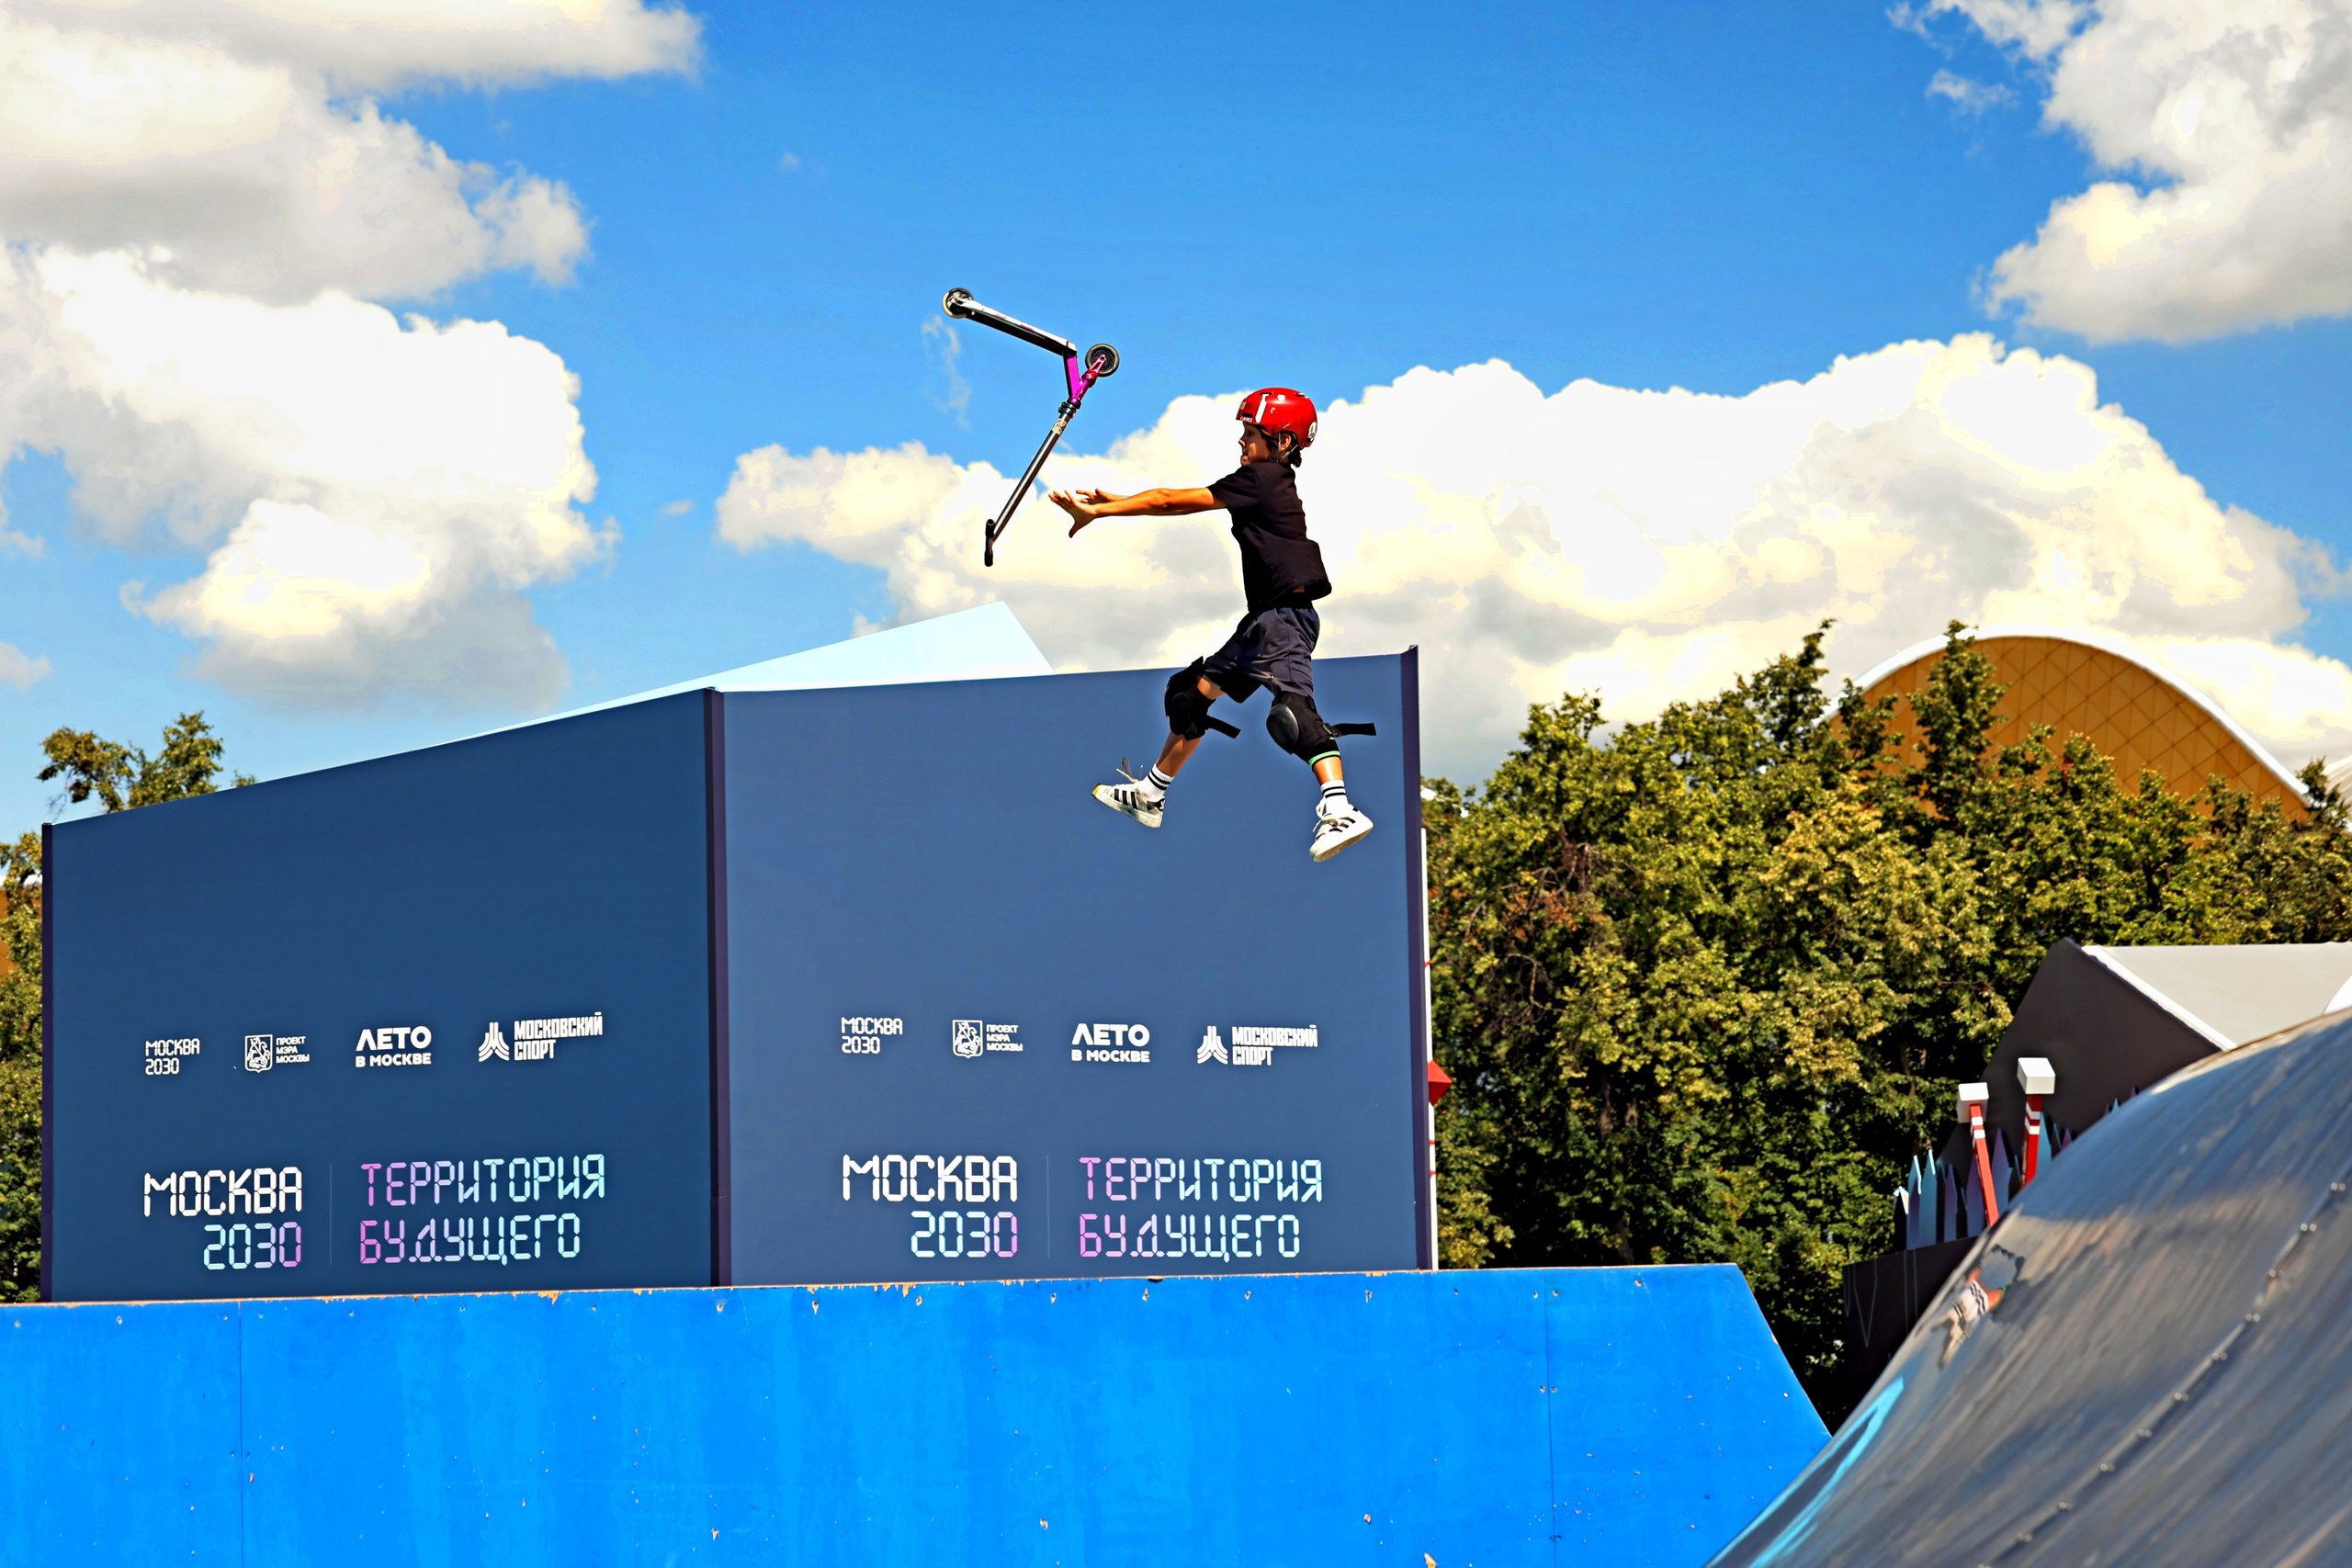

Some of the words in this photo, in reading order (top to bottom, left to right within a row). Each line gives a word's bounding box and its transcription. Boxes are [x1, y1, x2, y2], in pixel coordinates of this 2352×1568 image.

[514, 1011, 603, 1040] МОСКОВСКИЙ
[841, 1017, 903, 1035] МОСКВА
[986, 1024, 1019, 1033] ПРОЕКТ
[1071, 1023, 1150, 1046] ЛЕТО
[1232, 1024, 1318, 1047] МОСКОВСКИЙ
[145, 1038, 200, 1056] МОСКВА
[276, 1036, 306, 1045] ПРОЕКТ
[356, 1026, 432, 1051] ЛЕТО
[841, 1036, 881, 1055] 2030
[986, 1033, 1011, 1043] МЭРА
[986, 1043, 1023, 1052] МОСКВЫ
[276, 1045, 299, 1055] МЭРА
[276, 1054, 311, 1064] МОСКВЫ
[356, 1055, 366, 1067] В
[370, 1053, 432, 1066] МОСКВЕ
[514, 1039, 556, 1061] СПОРТ
[1071, 1049, 1082, 1061] В
[1087, 1050, 1150, 1062] МОСКВЕ
[1232, 1046, 1272, 1066] СПОРТ
[145, 1057, 179, 1075] 2030
[361, 1154, 605, 1207] ТЕРРИТОРИЯ
[842, 1155, 1018, 1202] МОСКВА
[1079, 1156, 1323, 1202] ТЕРРИТОРИЯ
[144, 1167, 302, 1217] МОСКВА
[360, 1213, 581, 1266] БУДУЩЕГО
[910, 1211, 1018, 1258] 2030
[1079, 1213, 1300, 1263] БУДУЩЕГО
[203, 1222, 302, 1269] 2030
